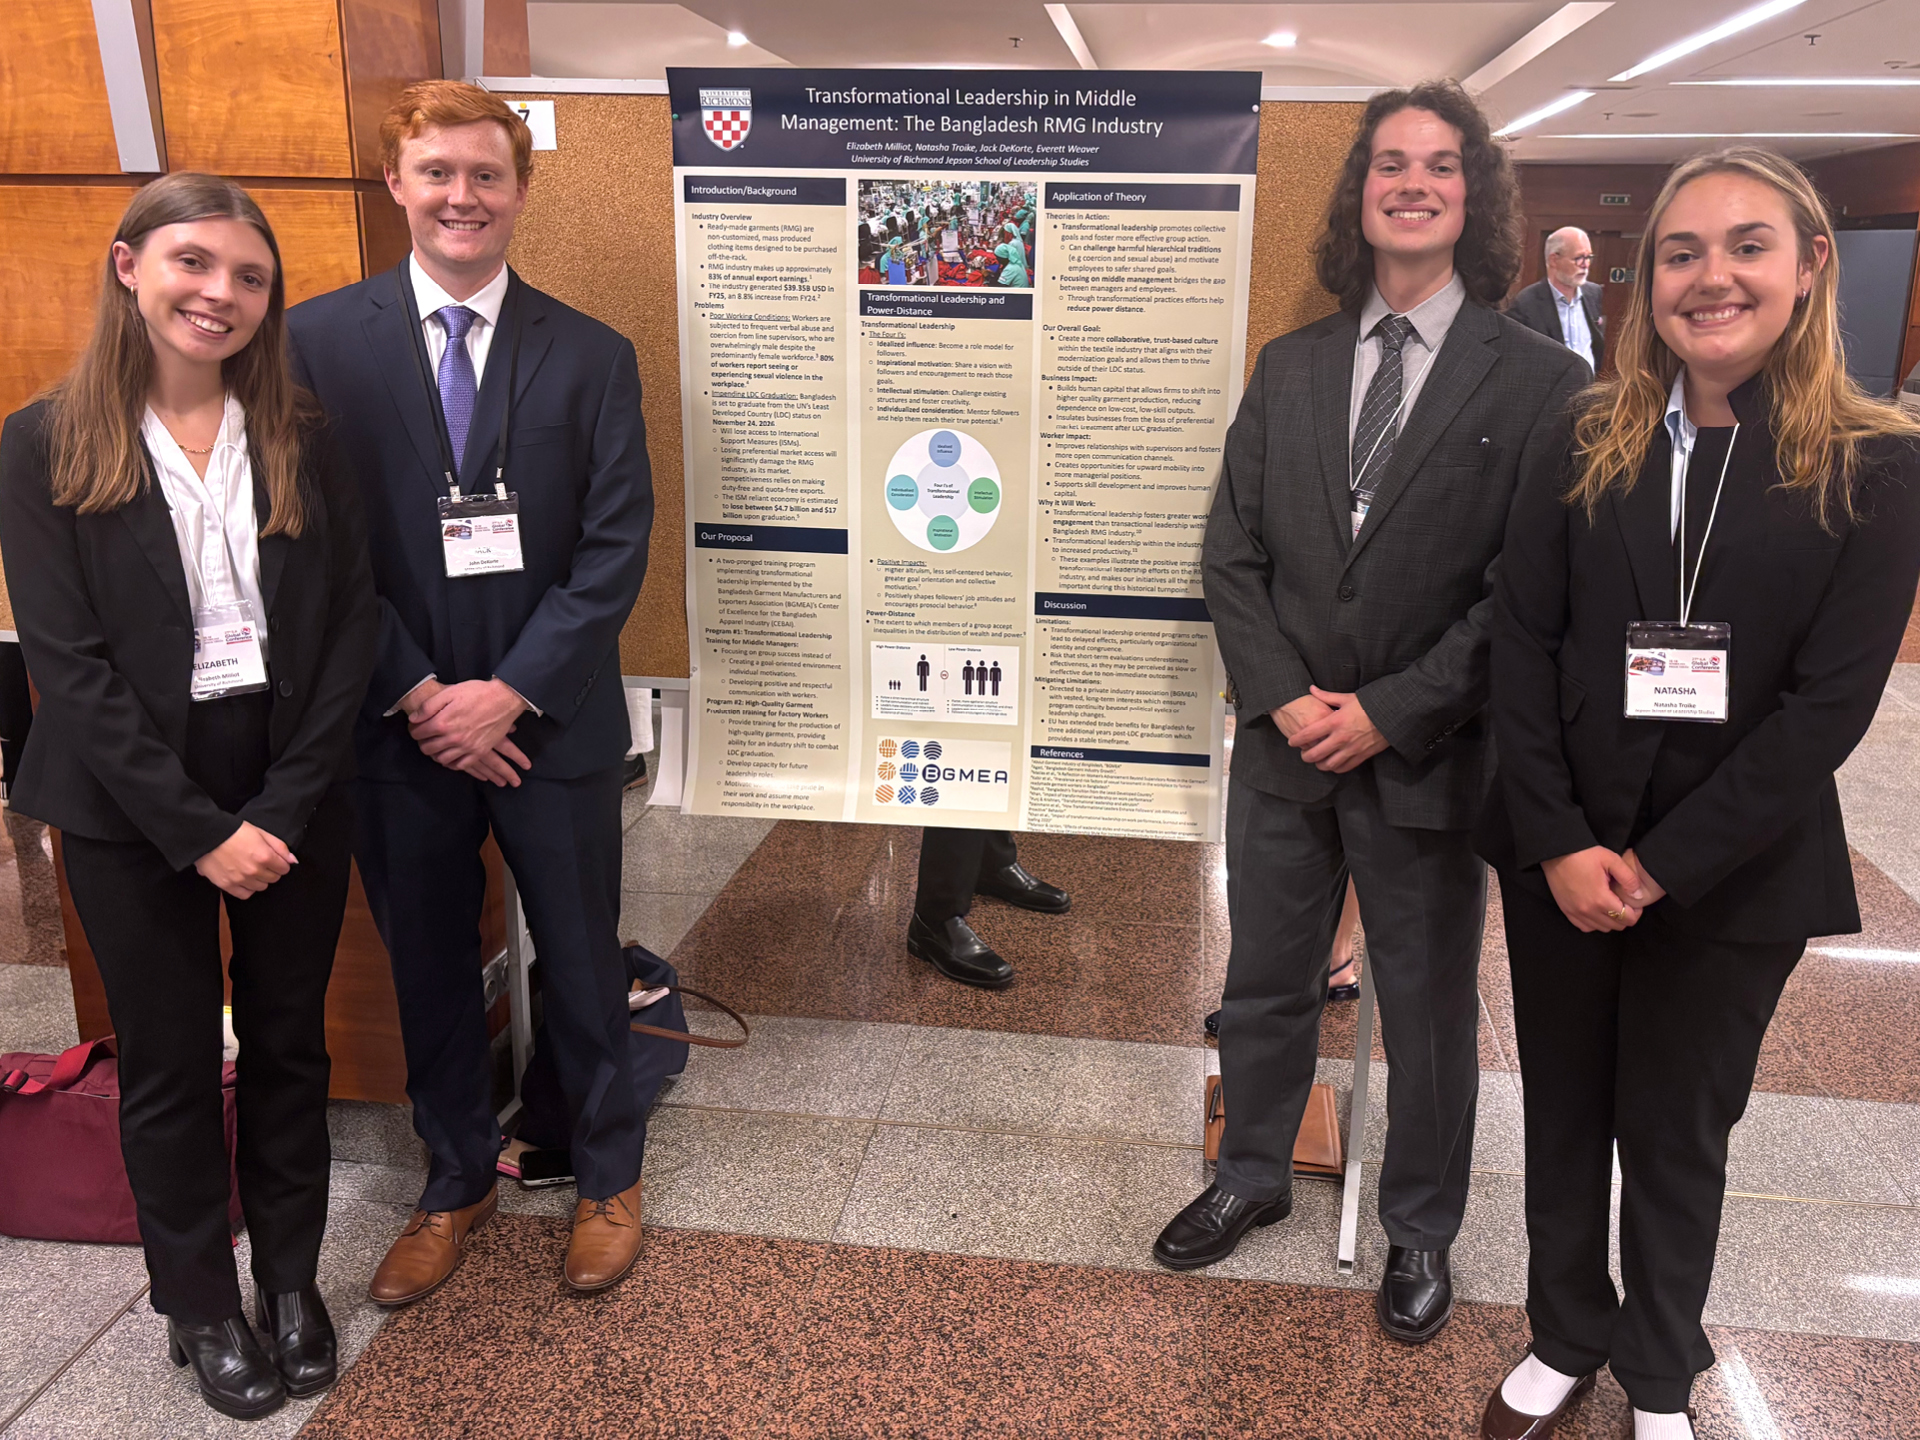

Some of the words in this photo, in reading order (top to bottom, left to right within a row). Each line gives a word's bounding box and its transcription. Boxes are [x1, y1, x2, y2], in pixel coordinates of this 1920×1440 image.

[805, 87, 950, 105] Transformational
[957, 89, 1049, 109] Leadership
[1055, 90, 1069, 105] in
[1076, 90, 1137, 107] Middle
[781, 114, 899, 134] Management:
[904, 116, 935, 132] The
[941, 116, 1037, 136] Bangladesh
[1044, 117, 1086, 133] RMG
[1092, 117, 1163, 137] Industry
[846, 142, 883, 150] Elizabeth
[885, 142, 913, 152] Milliot,
[952, 144, 978, 153] Troike,
[979, 144, 997, 152] Jack
[1000, 145, 1034, 154] DeKorte,
[1036, 145, 1065, 153] Everett
[851, 155, 891, 165] University
[893, 155, 902, 165] of
[904, 156, 943, 164] Richmond
[945, 157, 972, 166] Jepson
[975, 157, 1001, 165] School
[1003, 158, 1012, 166] of
[1014, 158, 1058, 167] Leadership
[691, 186, 797, 197] Introduction/Background
[1052, 192, 1101, 202] Application
[1104, 193, 1114, 201] of
[1115, 193, 1146, 203] Theory
[692, 213, 719, 221] Industry
[1121, 224, 1158, 233] leadership
[1159, 225, 1192, 233] promotes
[1083, 245, 1116, 253] challenge
[867, 293, 938, 303] Transformational
[941, 295, 986, 305] Leadership
[989, 296, 1005, 304] and
[867, 306, 932, 315] Power-Distance
[1038, 499, 1053, 507] Why
[701, 532, 715, 540] Our
[718, 534, 753, 542] Proposal
[764, 560, 788, 568] training
[1044, 601, 1087, 609] Discussion
[705, 628, 731, 636] Program
[744, 629, 797, 637] Transformational
[799, 632, 832, 640] Leadership
[706, 637, 730, 645] Training
[193, 658, 238, 670] ELIZABETH
[1035, 677, 1065, 685] Mitigating
[1654, 687, 1696, 695] NATASHA
[745, 700, 784, 708] High-Quality
[1151, 723, 1184, 731] Bangladesh
[1040, 749, 1084, 758] References
[922, 764, 1008, 783] BGMEA
